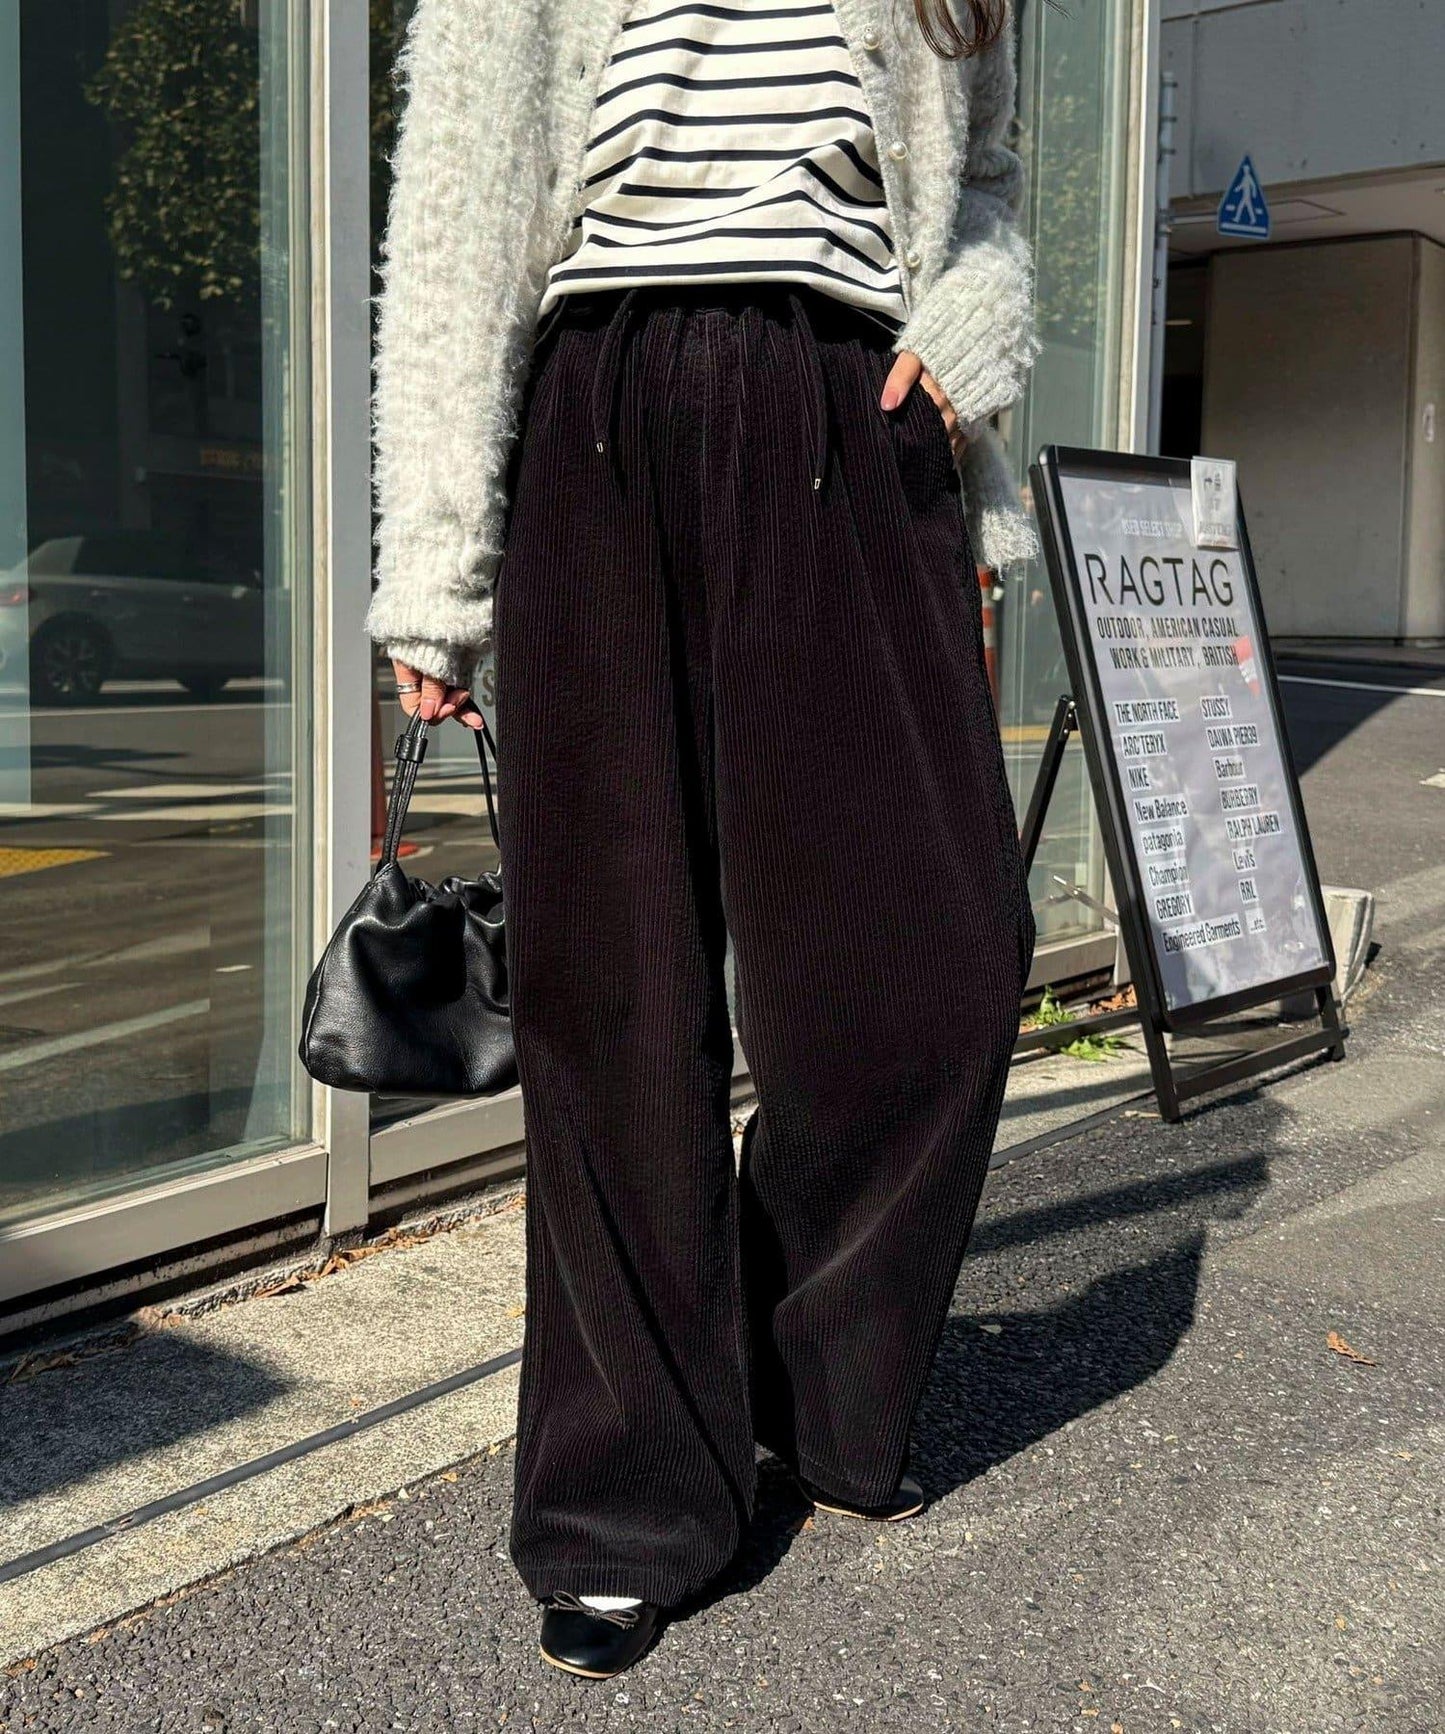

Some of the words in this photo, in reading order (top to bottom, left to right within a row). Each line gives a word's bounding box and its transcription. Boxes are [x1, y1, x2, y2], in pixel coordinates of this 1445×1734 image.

[1084, 553, 1235, 607] RAGTAG
[1150, 617, 1201, 638] AMERICAN
[1201, 617, 1239, 638] CASUAL
[1110, 647, 1141, 669] WORK
[1140, 650, 1149, 668] &
[1201, 645, 1240, 667] BRITISH
[1115, 703, 1132, 723] THE
[1131, 702, 1159, 721] NORTH
[1159, 700, 1179, 720] FACE
[1201, 698, 1231, 718] STUSSY
[1207, 727, 1233, 748] DAIWA
[1233, 725, 1258, 745] PIER39
[1128, 767, 1150, 788] NIKE
[1215, 759, 1243, 778] Barbour
[1221, 787, 1258, 809] BURBERRY
[1135, 801, 1155, 822] New
[1154, 798, 1188, 818] Balance
[1227, 817, 1254, 839] RALPH
[1253, 814, 1281, 835] LAUREN
[1143, 828, 1184, 854] patagonia
[1148, 862, 1189, 887] Champion
[1240, 880, 1257, 901] RRL
[1156, 894, 1192, 920] GREGORY
[1163, 924, 1206, 953] Engineered
[1205, 917, 1241, 942] Garments
